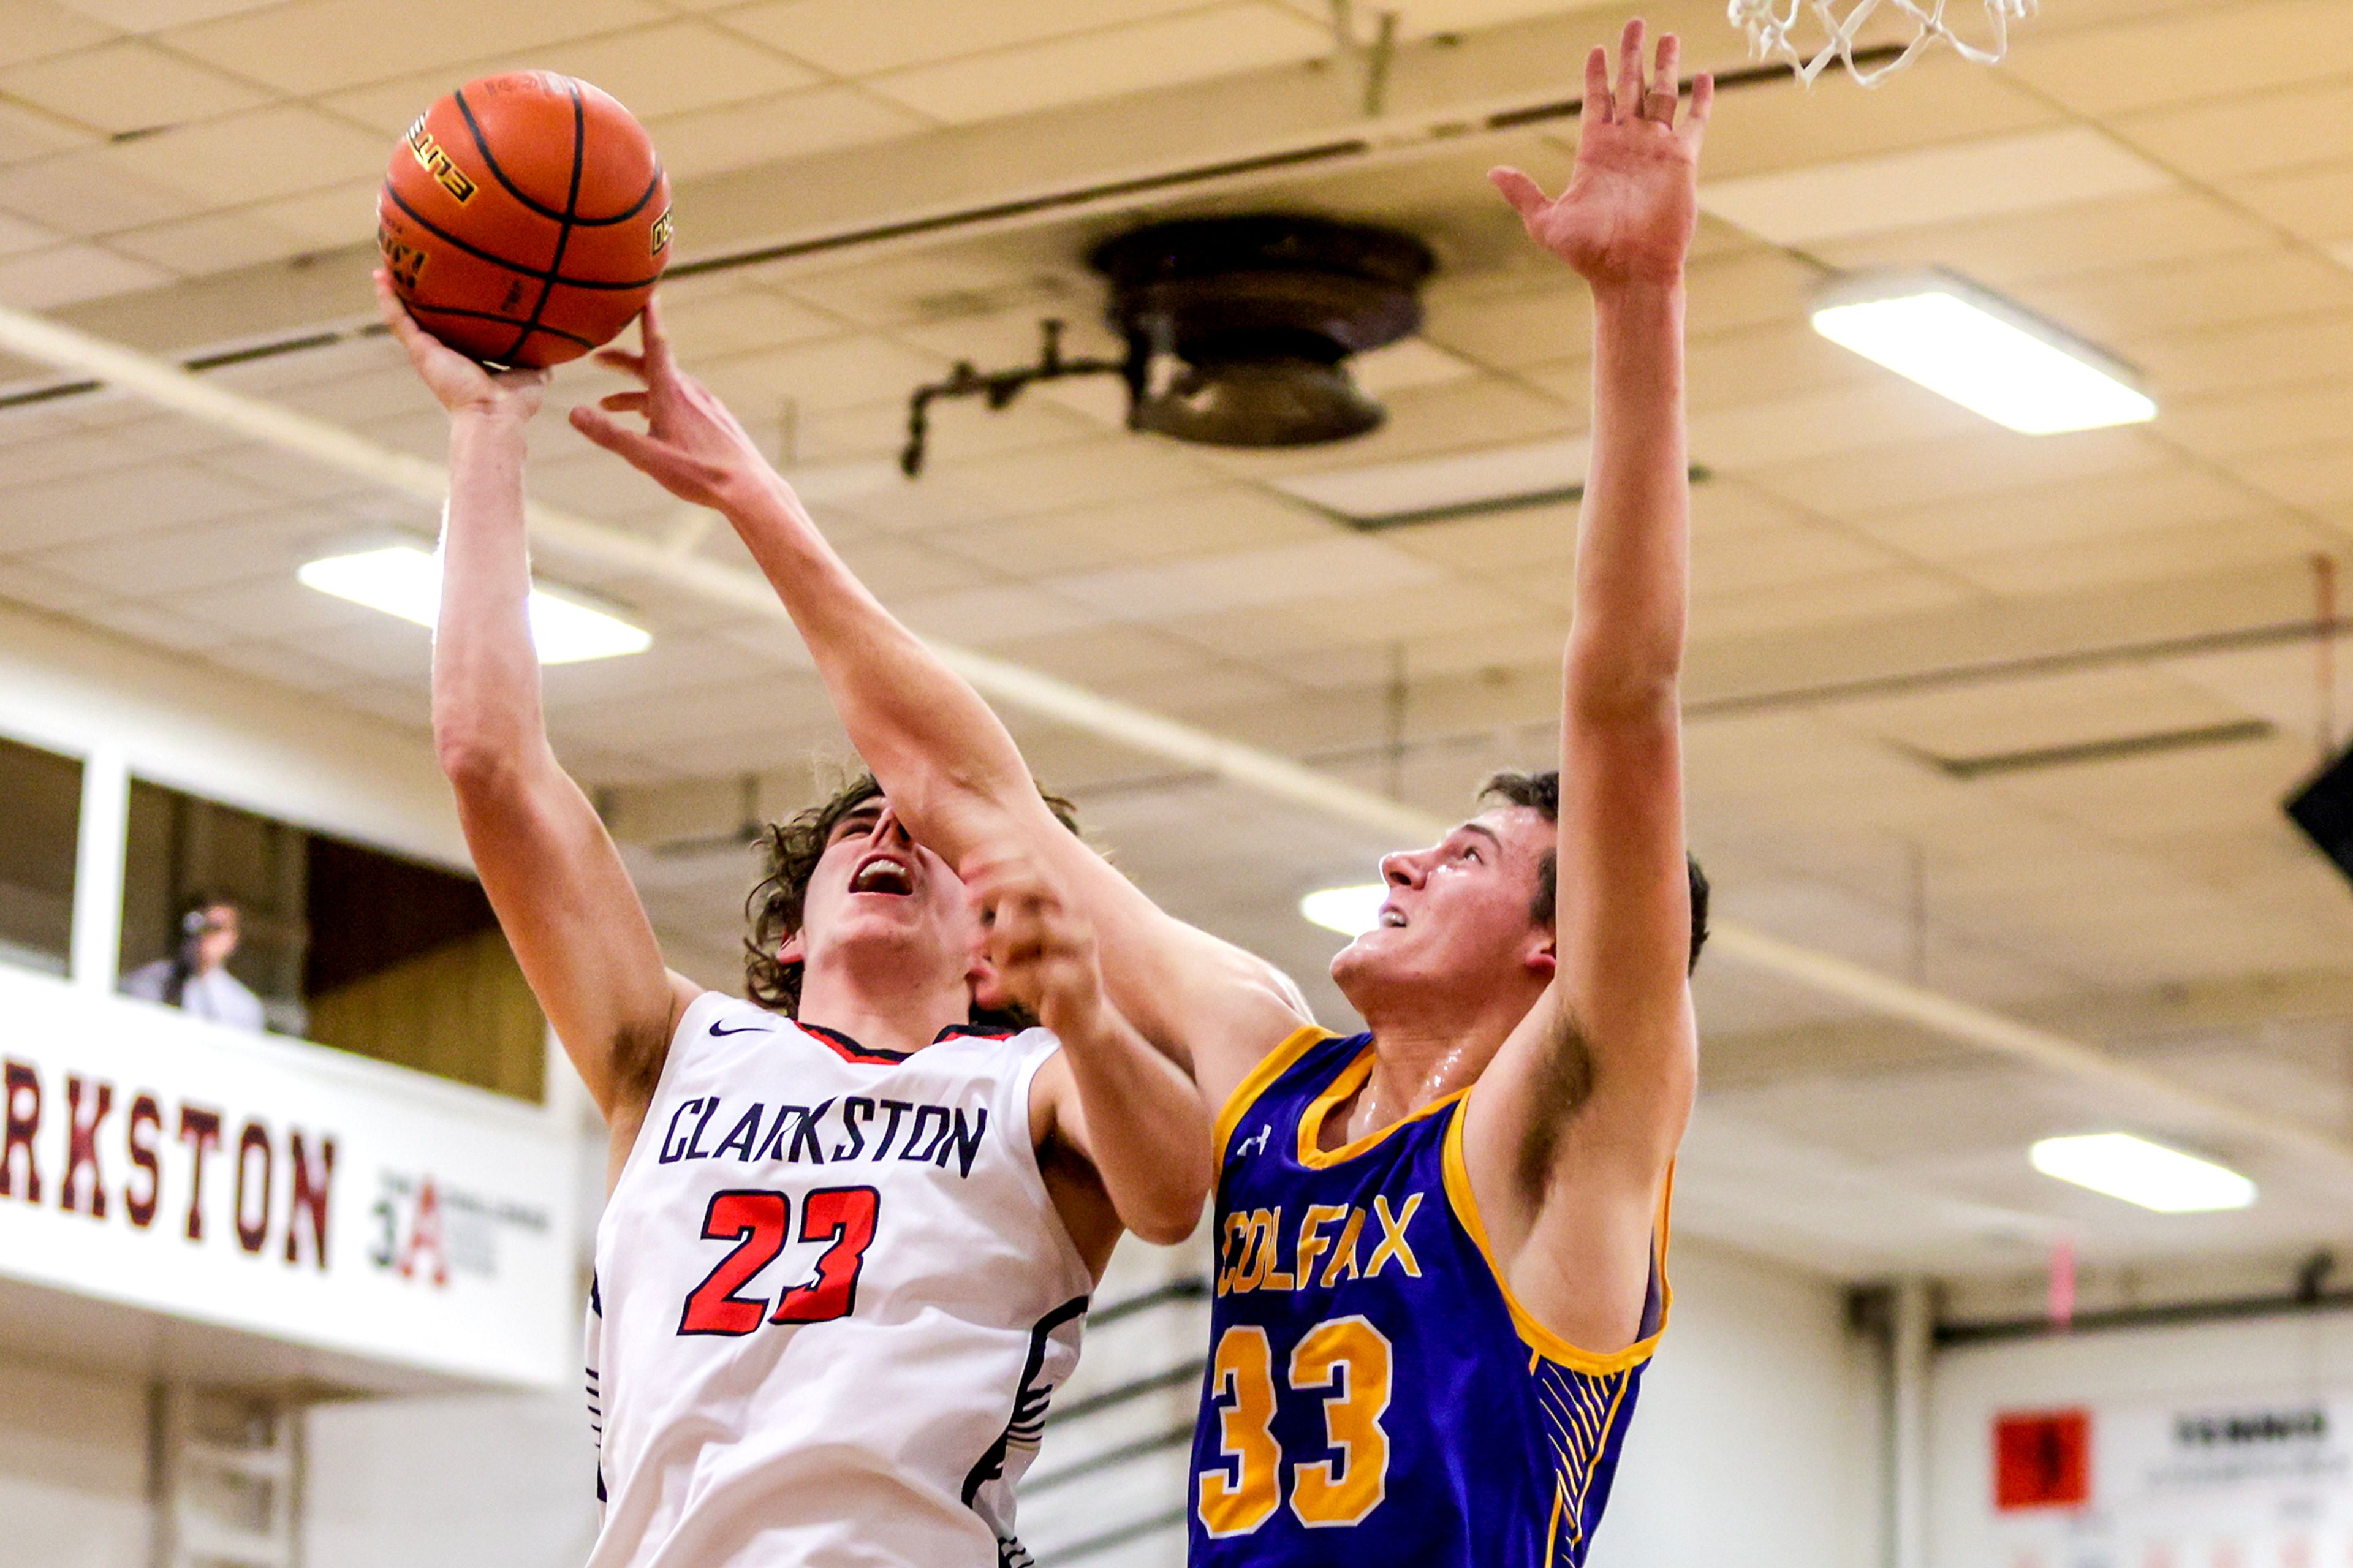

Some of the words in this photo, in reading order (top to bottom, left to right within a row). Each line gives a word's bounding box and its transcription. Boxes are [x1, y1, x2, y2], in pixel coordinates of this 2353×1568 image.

[659, 1096, 988, 1179] CLARKSTON
[676, 1185, 881, 1336] 23
[1217, 1192, 1425, 1298] COLFAX
[1198, 1314, 1393, 1539] 33
